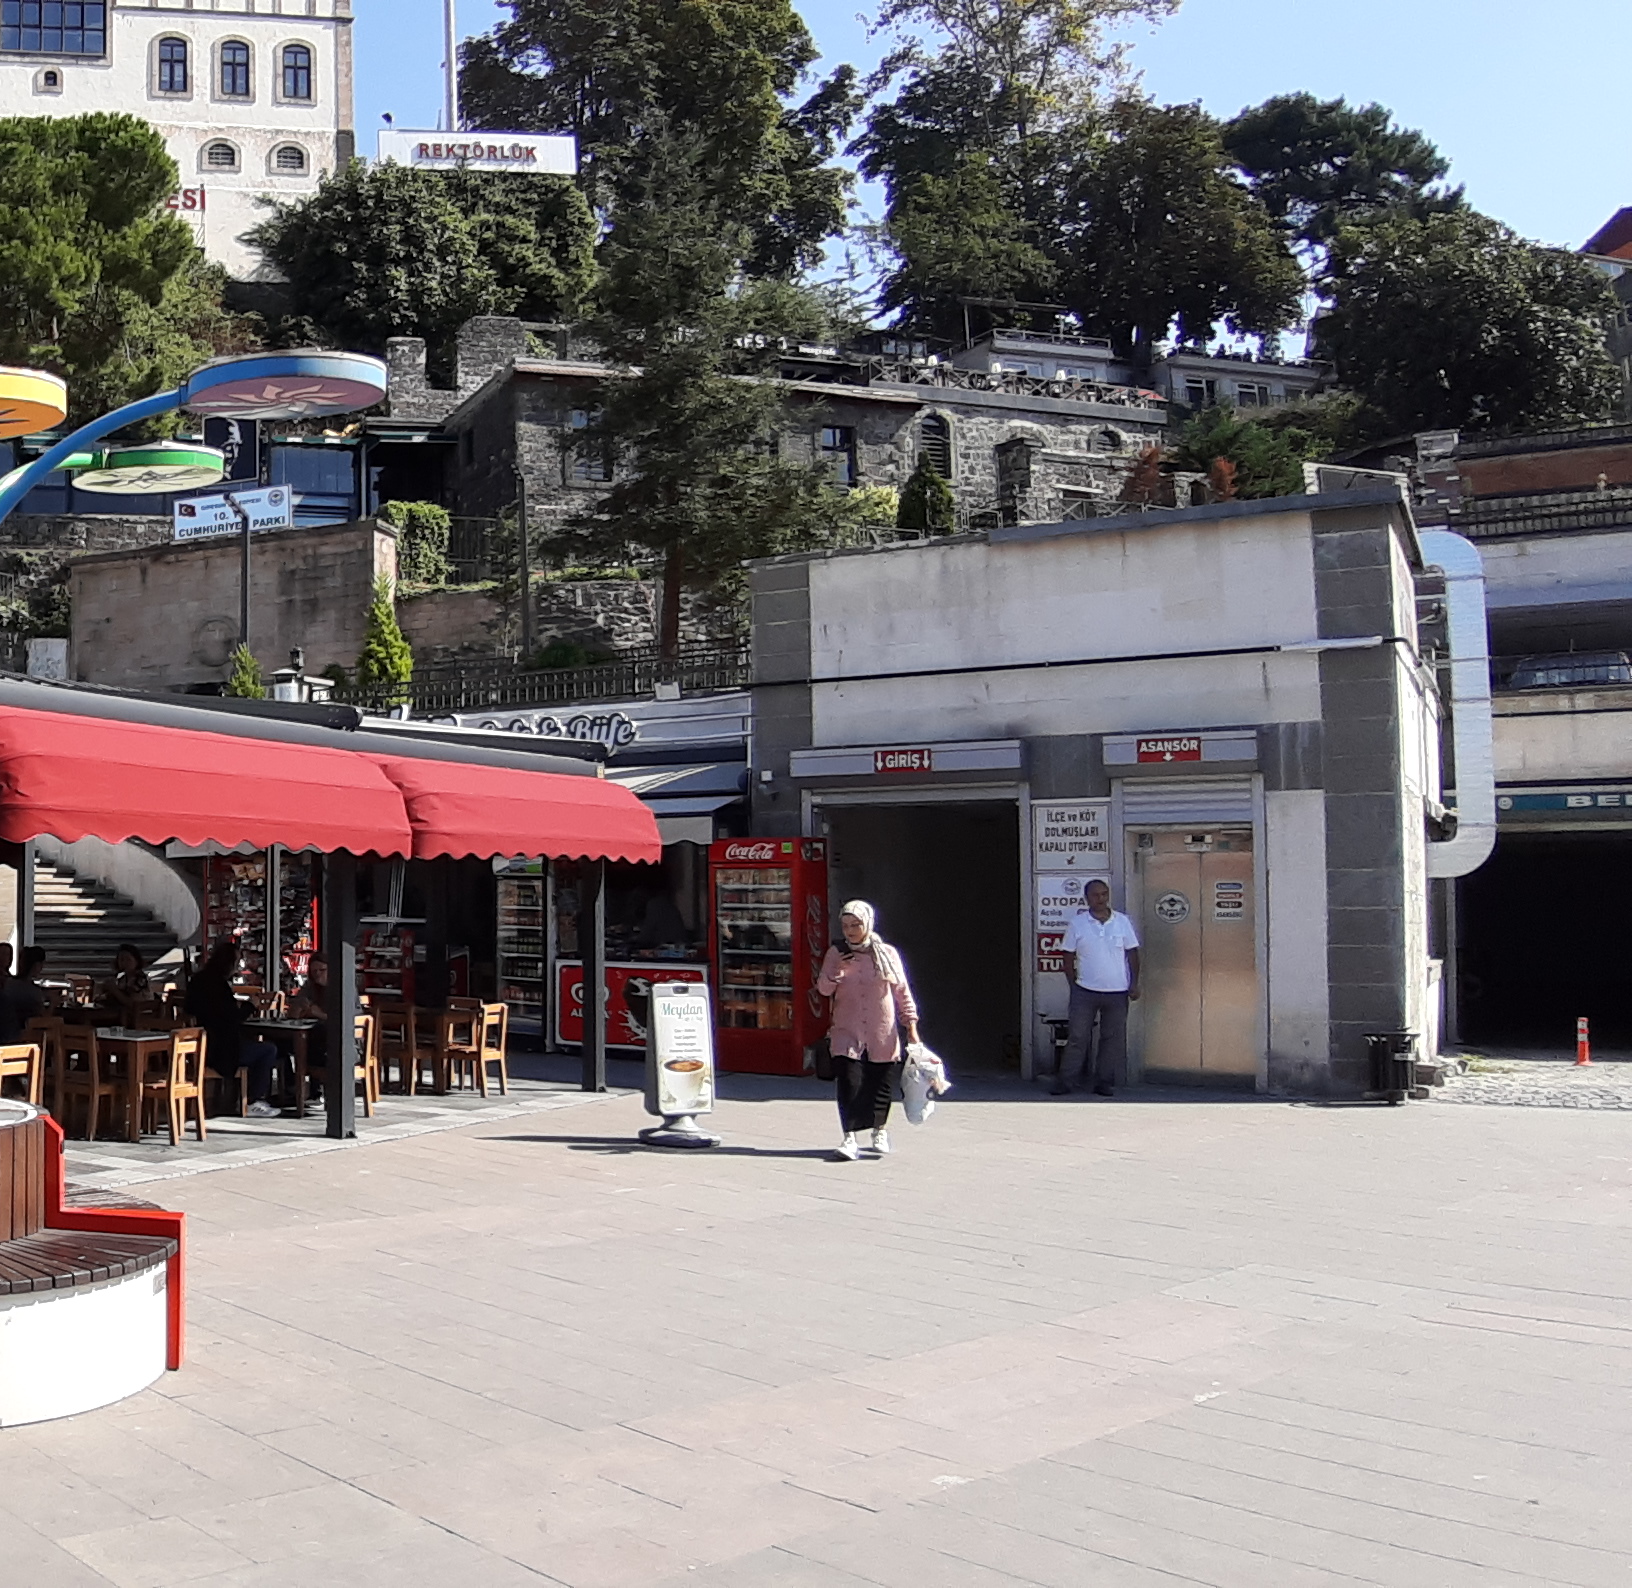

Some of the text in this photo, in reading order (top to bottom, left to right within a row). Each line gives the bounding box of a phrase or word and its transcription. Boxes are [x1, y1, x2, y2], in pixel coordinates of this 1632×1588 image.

[418, 141, 538, 162] REKTÖRLÜK
[179, 521, 243, 538] CUMHURİYE
[252, 515, 286, 529] PARKI
[570, 712, 633, 757] Büfe
[1140, 738, 1198, 753] ASANSÖR
[885, 751, 920, 770] GİRİŞ
[1046, 809, 1066, 823] İLÇE
[1045, 826, 1099, 838] DOLMUŞLARI
[1038, 841, 1107, 853] KAPALI OTOPARKI
[1040, 896, 1090, 907] OTOPA
[662, 1002, 703, 1020] Meydan
